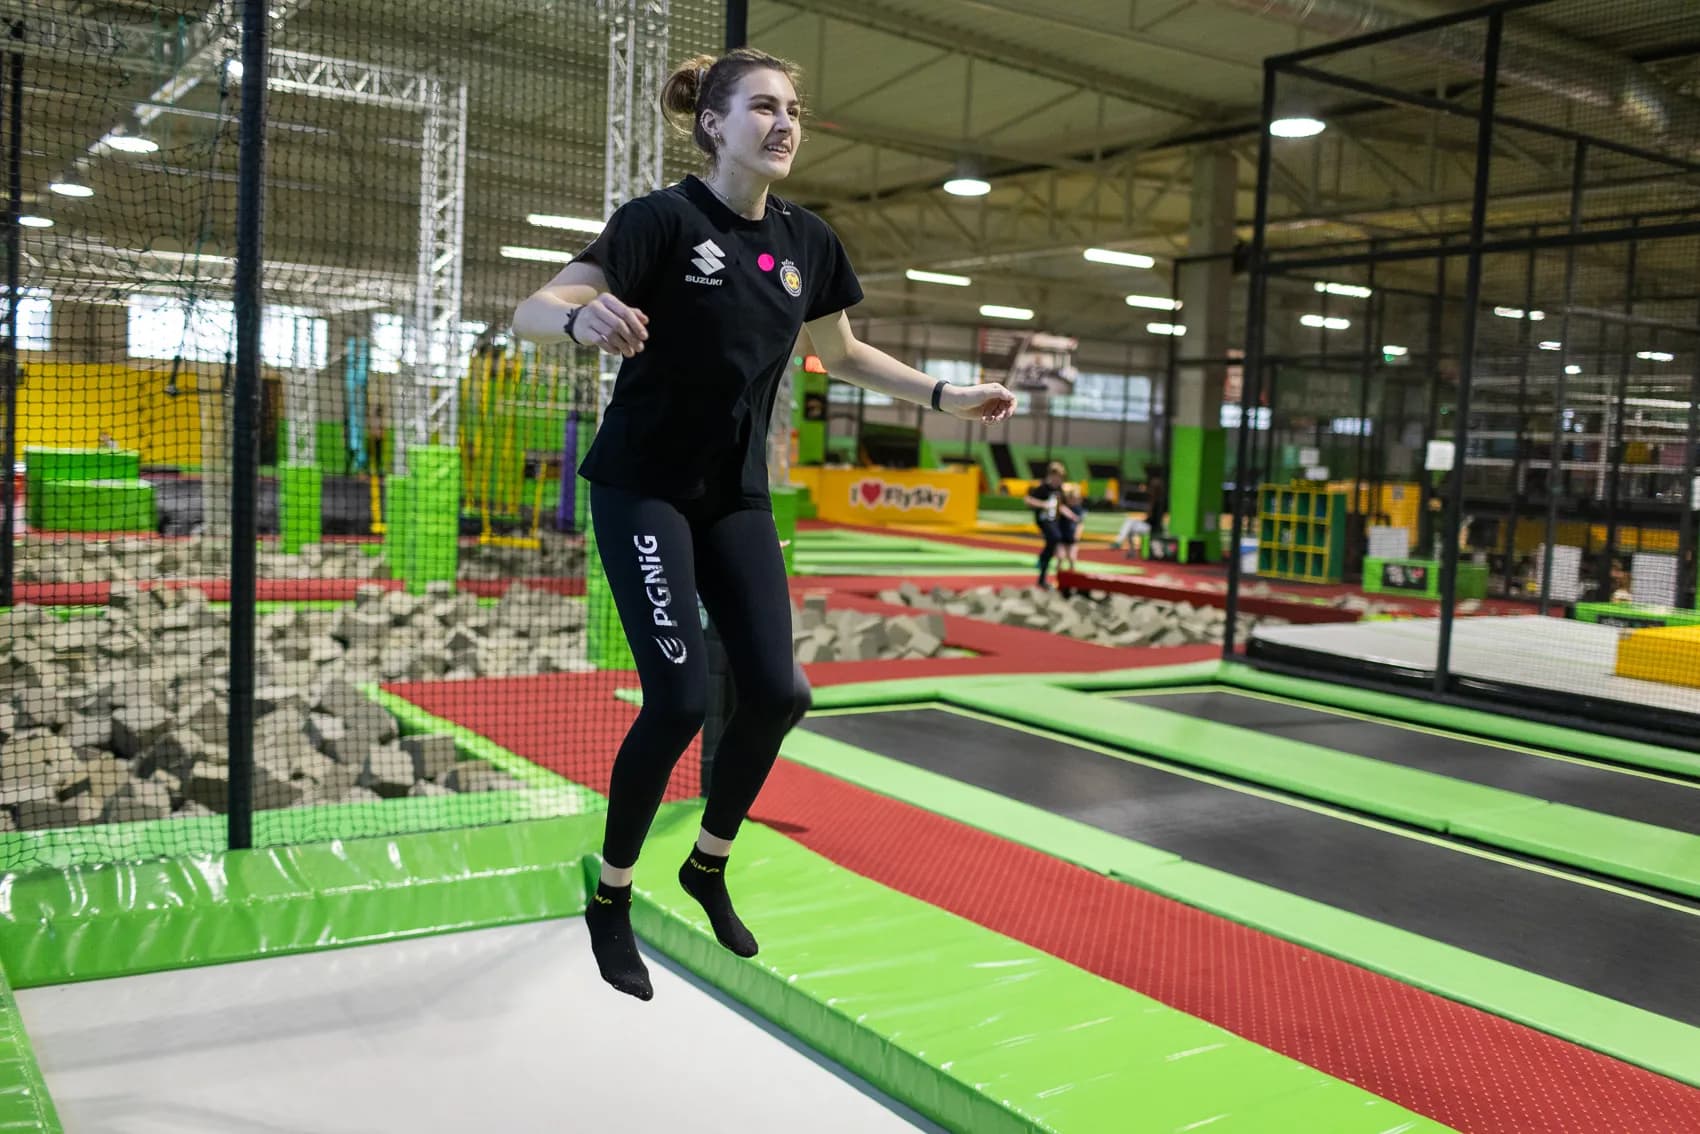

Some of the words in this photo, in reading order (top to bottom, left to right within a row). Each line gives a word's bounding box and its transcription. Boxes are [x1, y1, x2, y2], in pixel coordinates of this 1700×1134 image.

[685, 275, 723, 286] SUZUKI
[883, 486, 947, 509] FlySky
[633, 535, 678, 627] PGNiG
